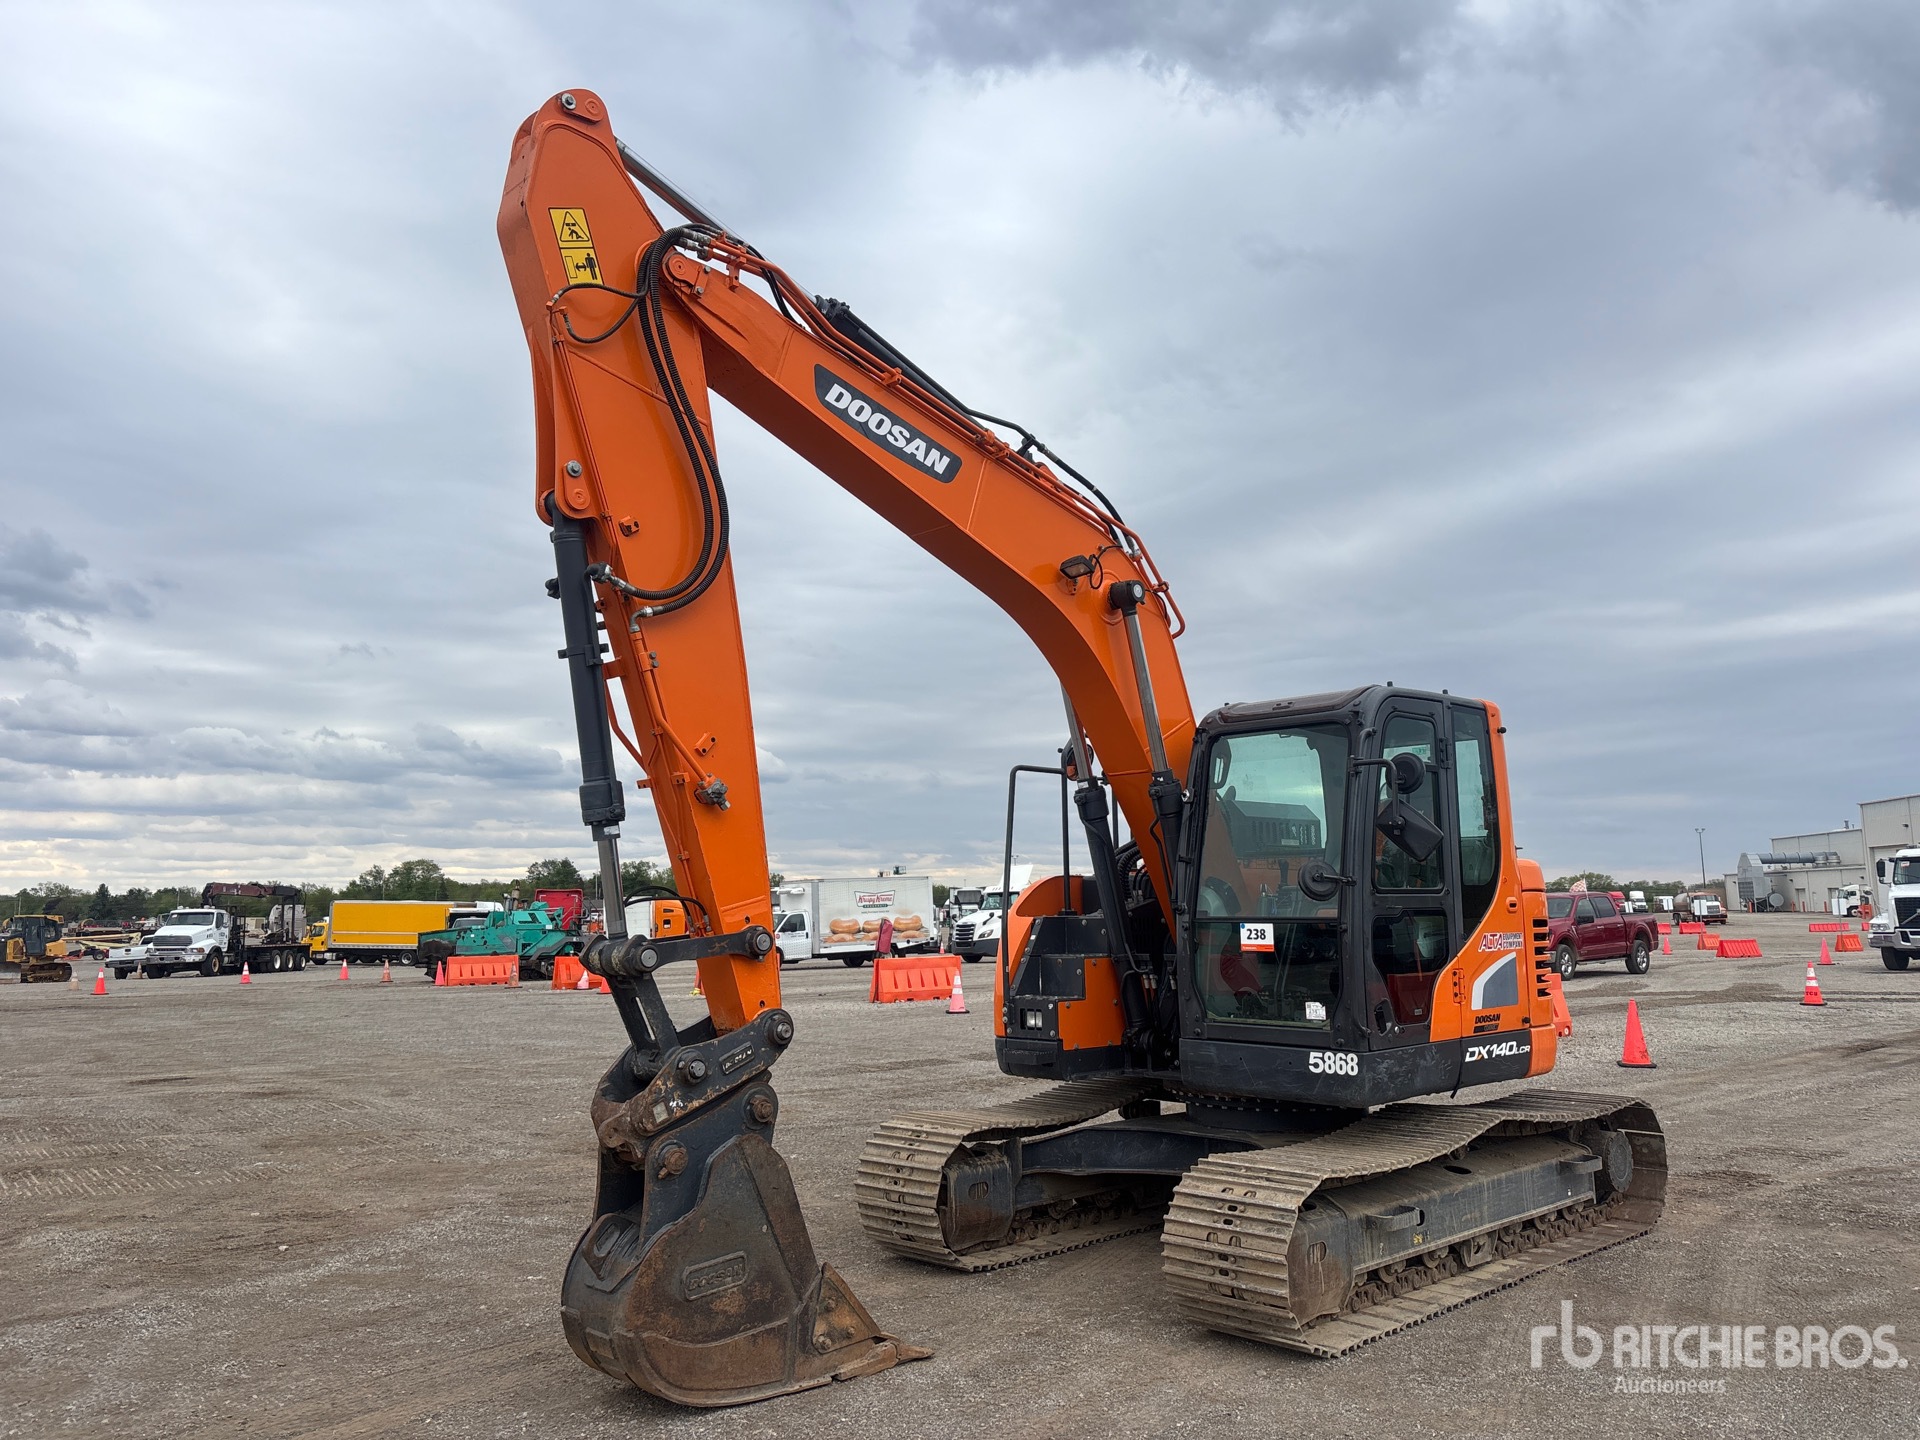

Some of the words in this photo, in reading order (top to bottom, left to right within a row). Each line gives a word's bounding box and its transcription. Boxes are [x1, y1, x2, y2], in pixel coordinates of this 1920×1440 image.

[824, 383, 950, 475] DOOSAN
[858, 894, 876, 904] Krispy
[875, 894, 893, 903] Kreme
[1246, 928, 1266, 940] 238
[1479, 933, 1503, 951] ALTA
[1475, 1013, 1501, 1025] DOOSAN
[1308, 1051, 1359, 1076] 5868
